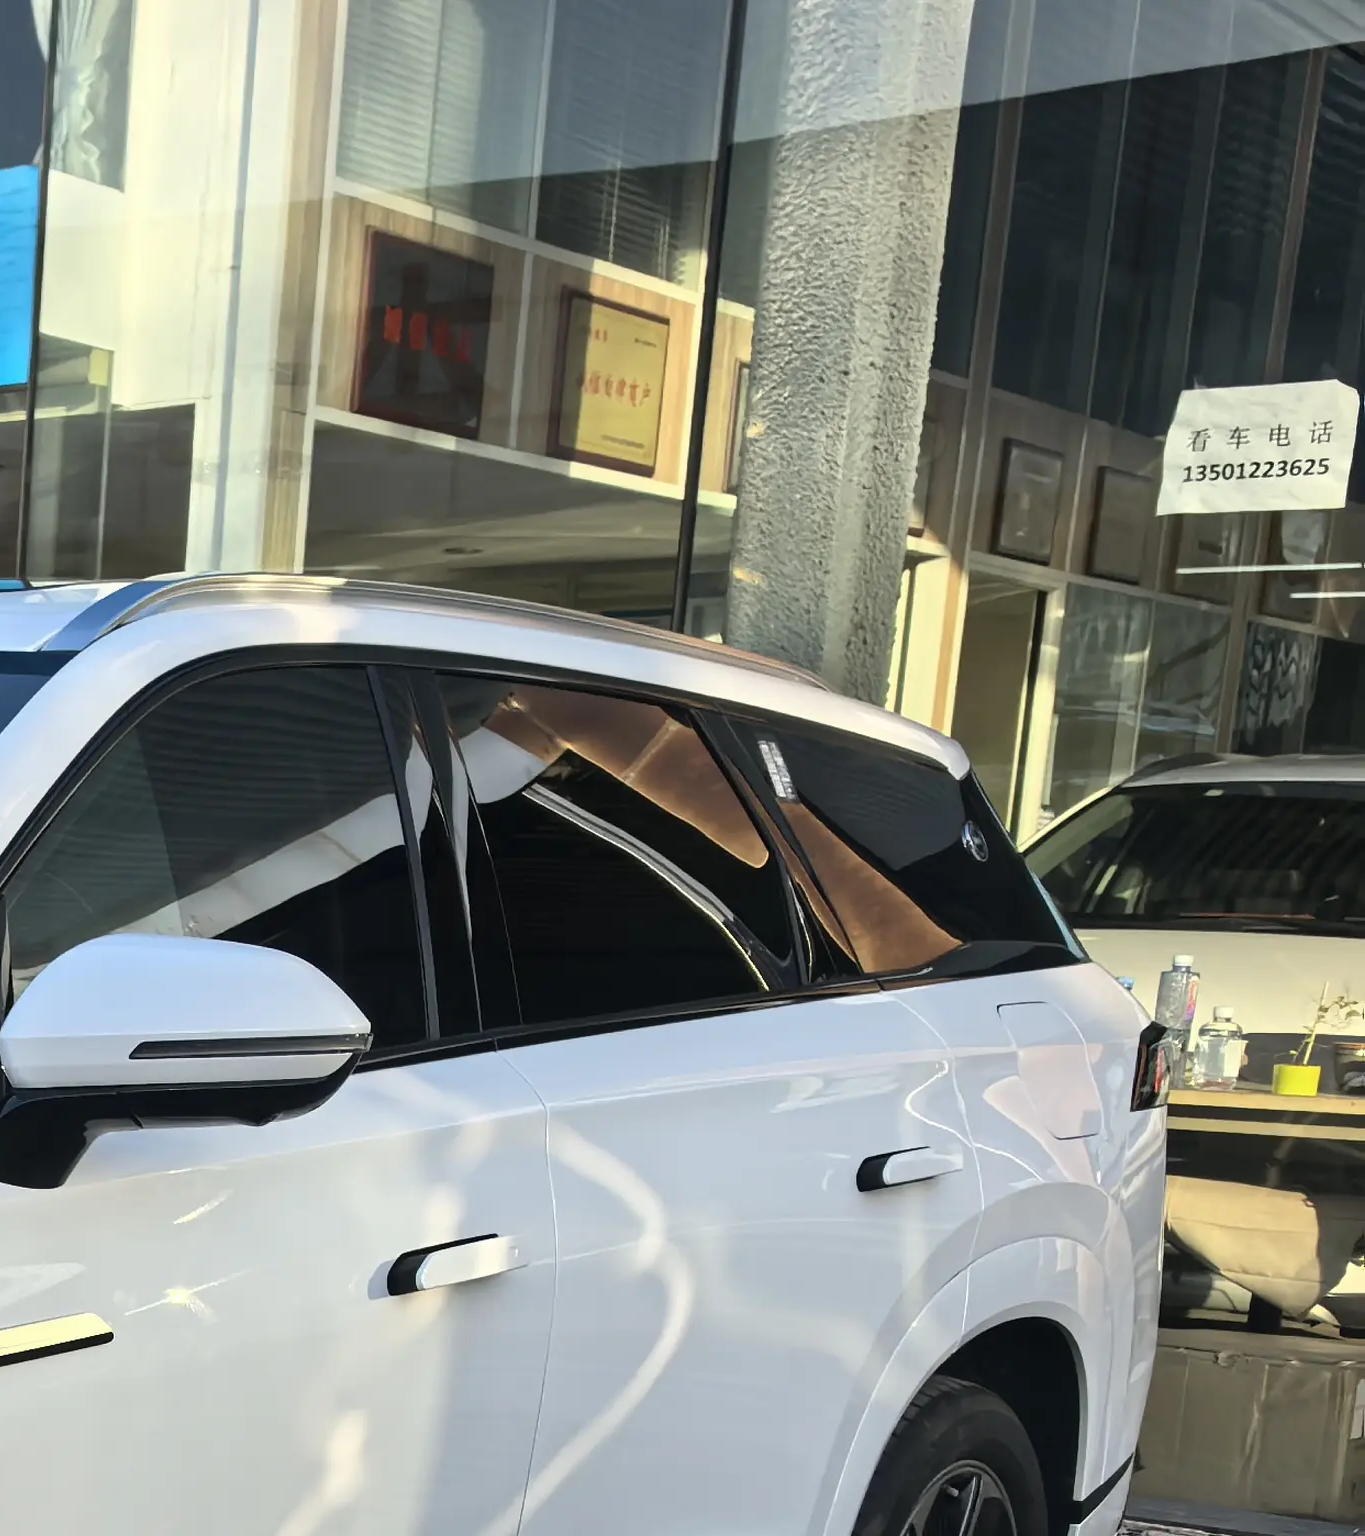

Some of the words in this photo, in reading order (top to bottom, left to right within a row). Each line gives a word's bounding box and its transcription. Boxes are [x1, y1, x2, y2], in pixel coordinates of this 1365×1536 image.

[1185, 419, 1334, 453] 看车电话
[1181, 457, 1331, 483] 13501223625
